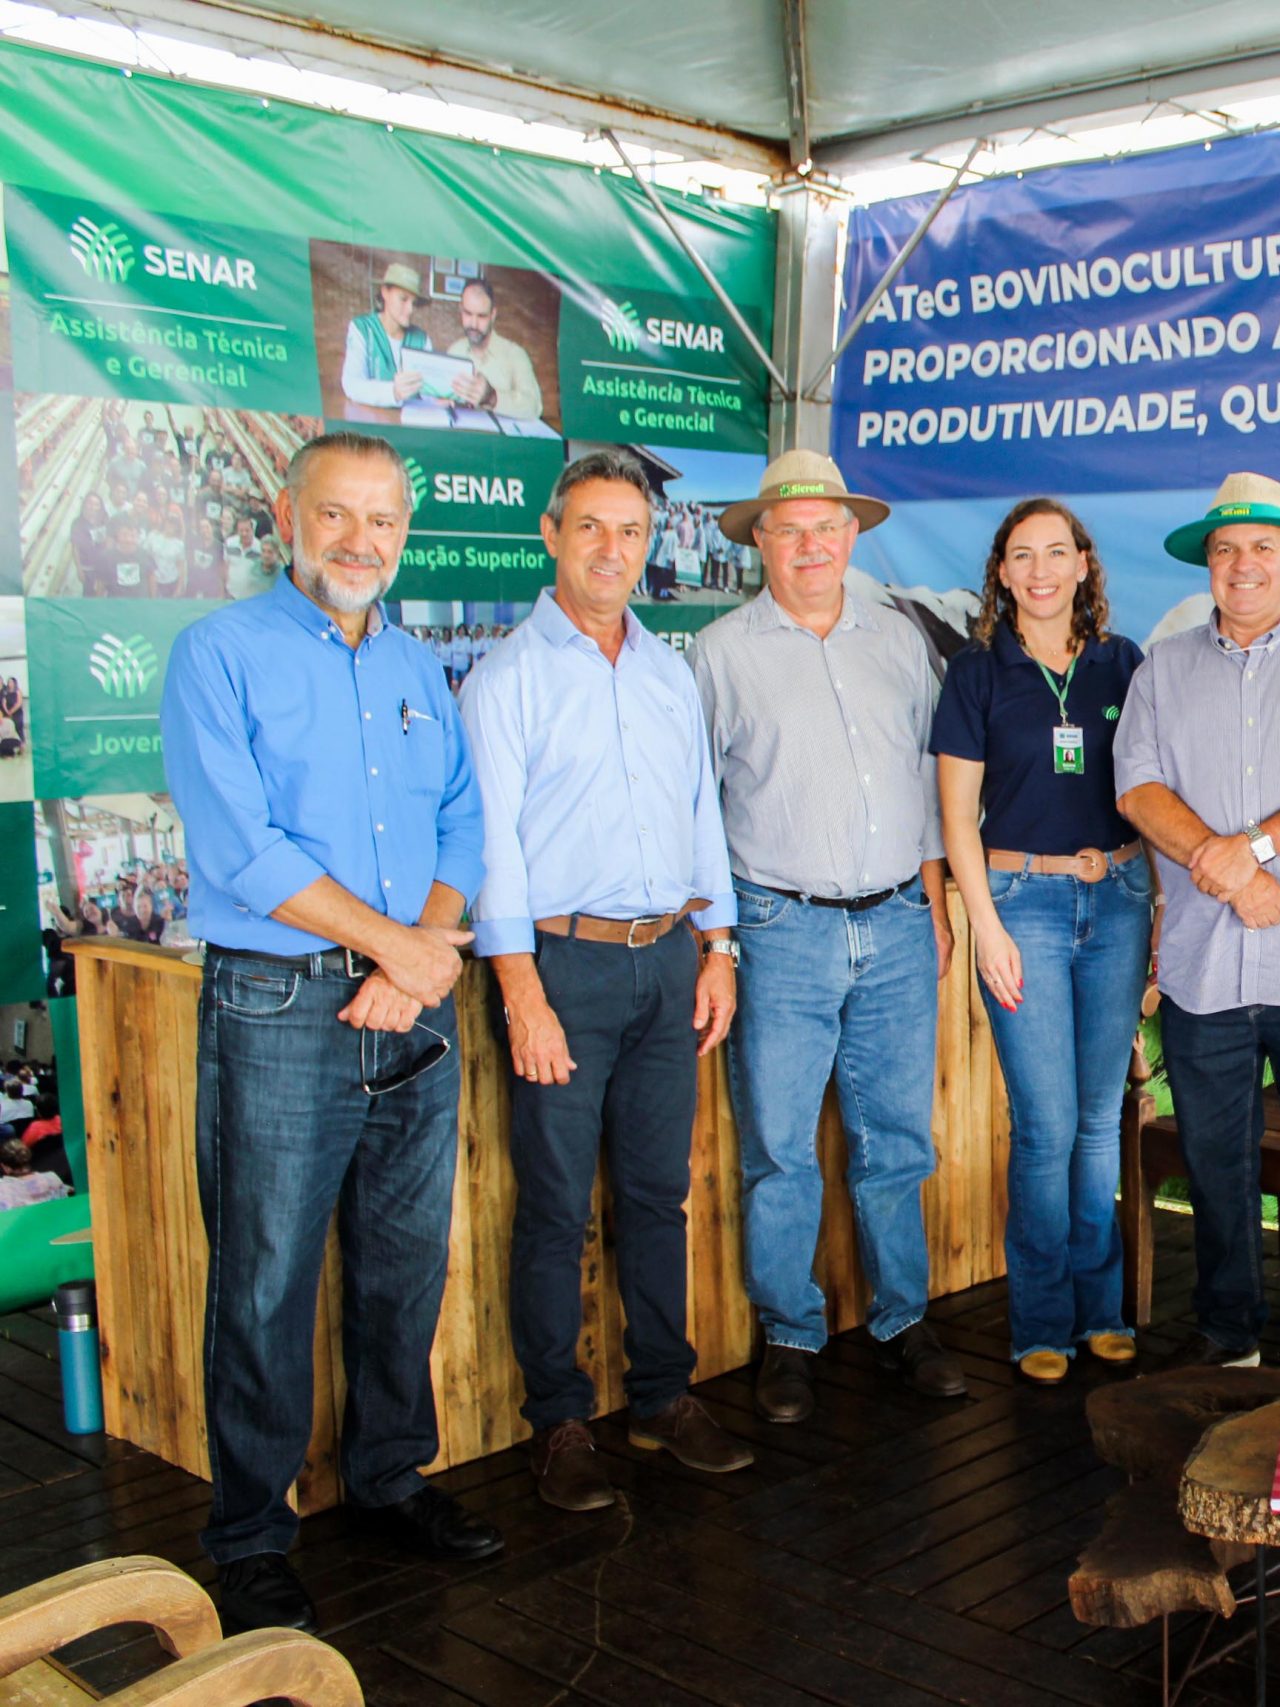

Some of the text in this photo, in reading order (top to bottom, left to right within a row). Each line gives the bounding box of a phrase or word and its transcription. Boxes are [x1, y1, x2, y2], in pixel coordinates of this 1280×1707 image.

[143, 245, 258, 291] SENAR
[865, 279, 961, 324] ATeG
[50, 312, 288, 362] Assistência Técnica
[646, 318, 725, 353] SENAR
[863, 311, 1261, 386] PROPORCIONANDO
[106, 356, 248, 388] e Gerencial
[582, 375, 742, 411] Assistência Técnica
[619, 407, 715, 433] e Gerencial
[857, 389, 1209, 448] PRODUTIVIDADE,
[434, 473, 526, 507] SENAR
[465, 546, 546, 572] Superior
